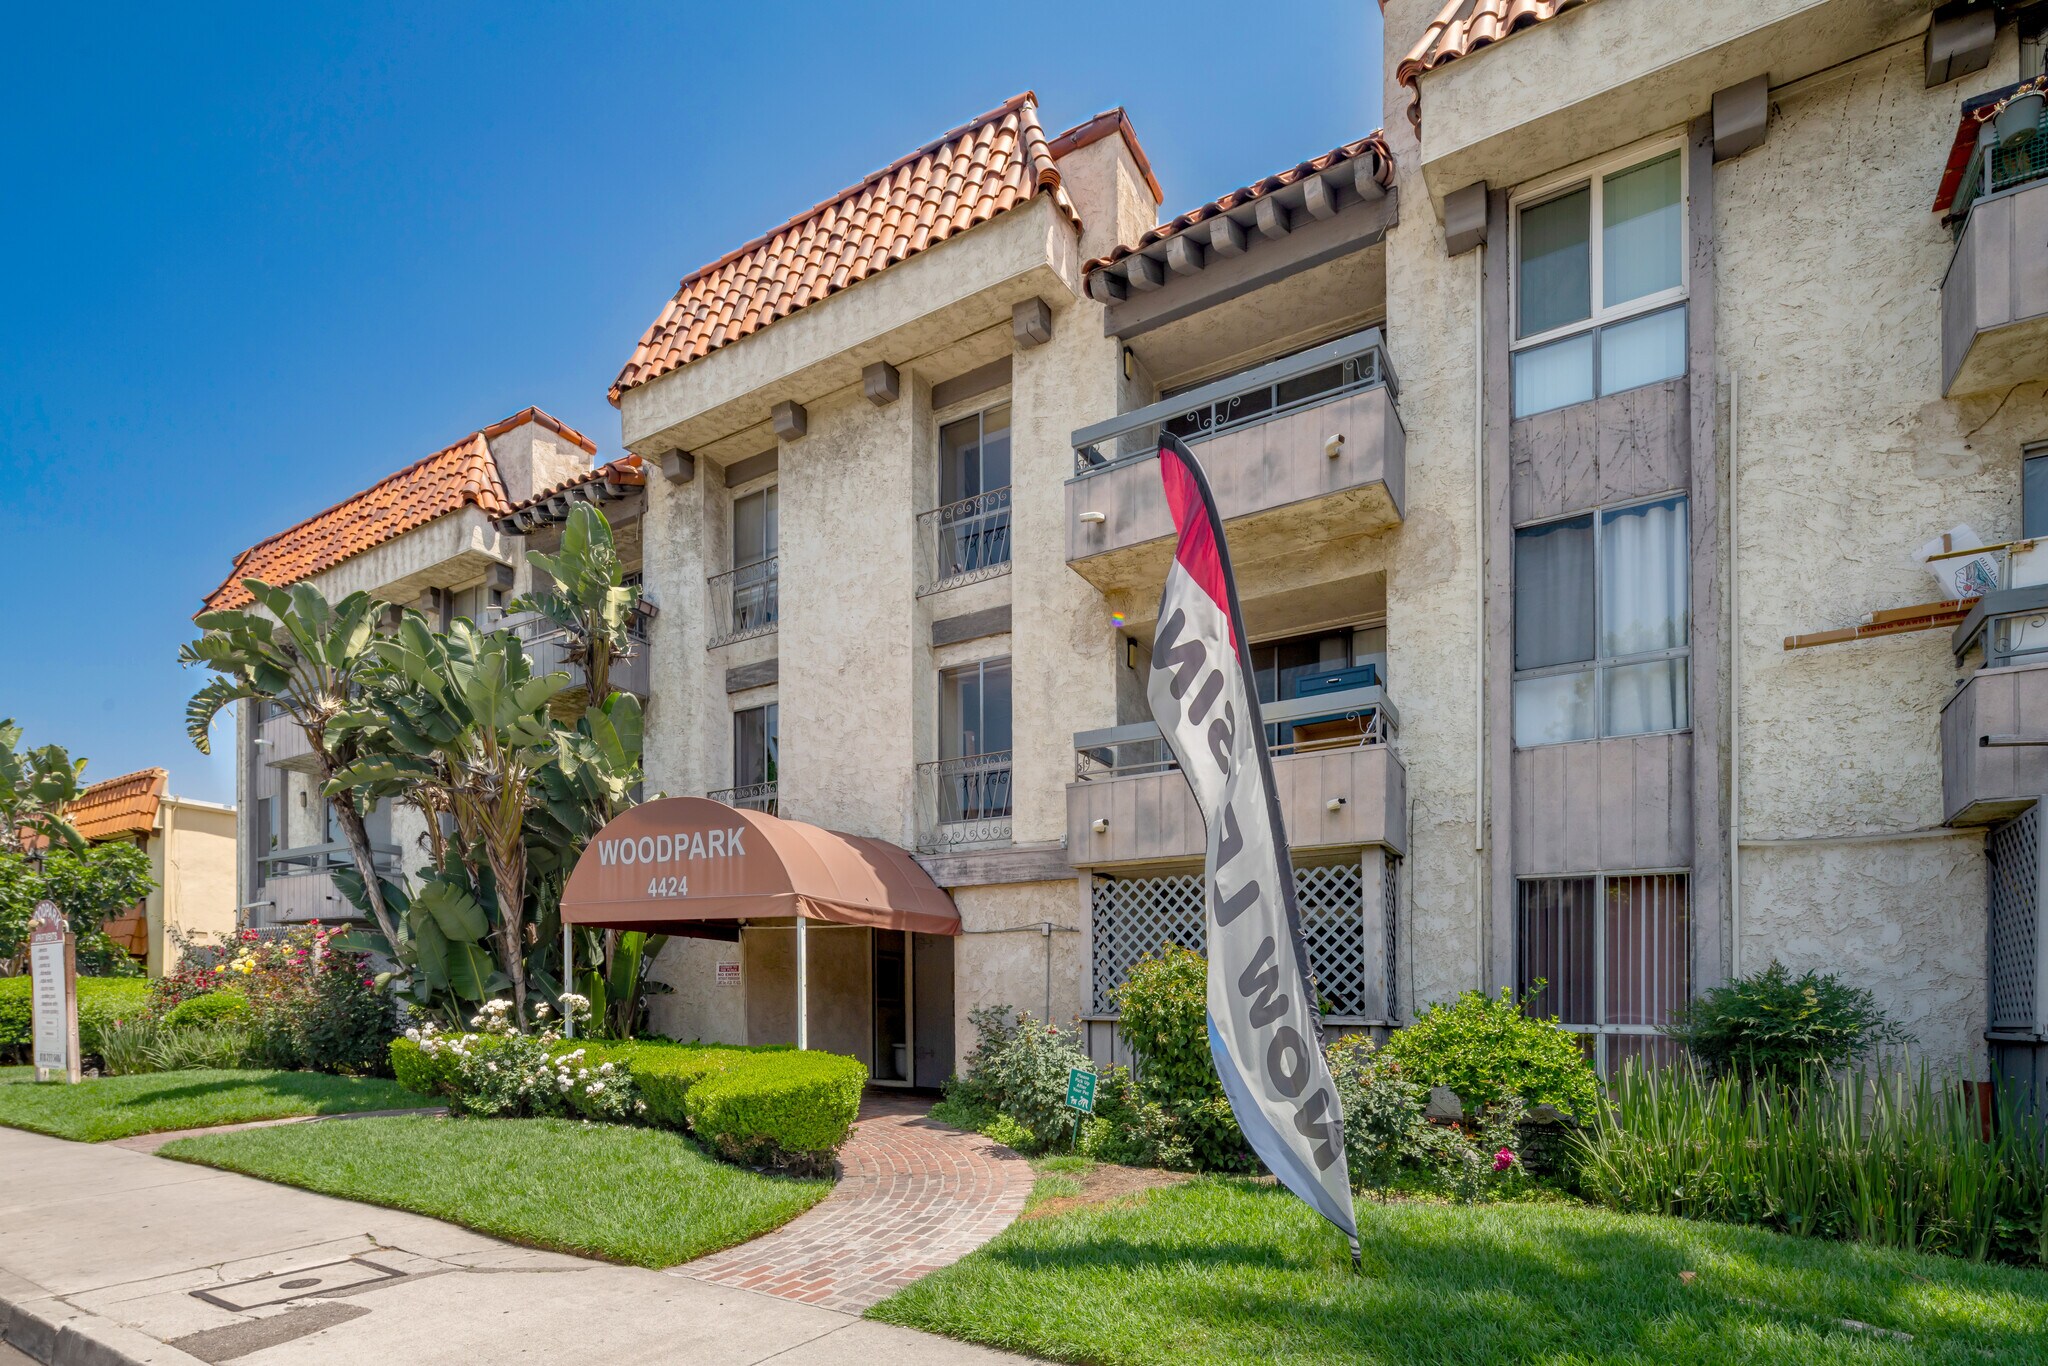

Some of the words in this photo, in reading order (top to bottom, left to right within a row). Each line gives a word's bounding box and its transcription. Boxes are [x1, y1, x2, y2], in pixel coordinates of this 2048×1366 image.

[1858, 623, 1894, 633] SLIDING
[598, 826, 746, 866] WOODPARK
[647, 875, 688, 897] 4424
[33, 903, 61, 930] OODPARK
